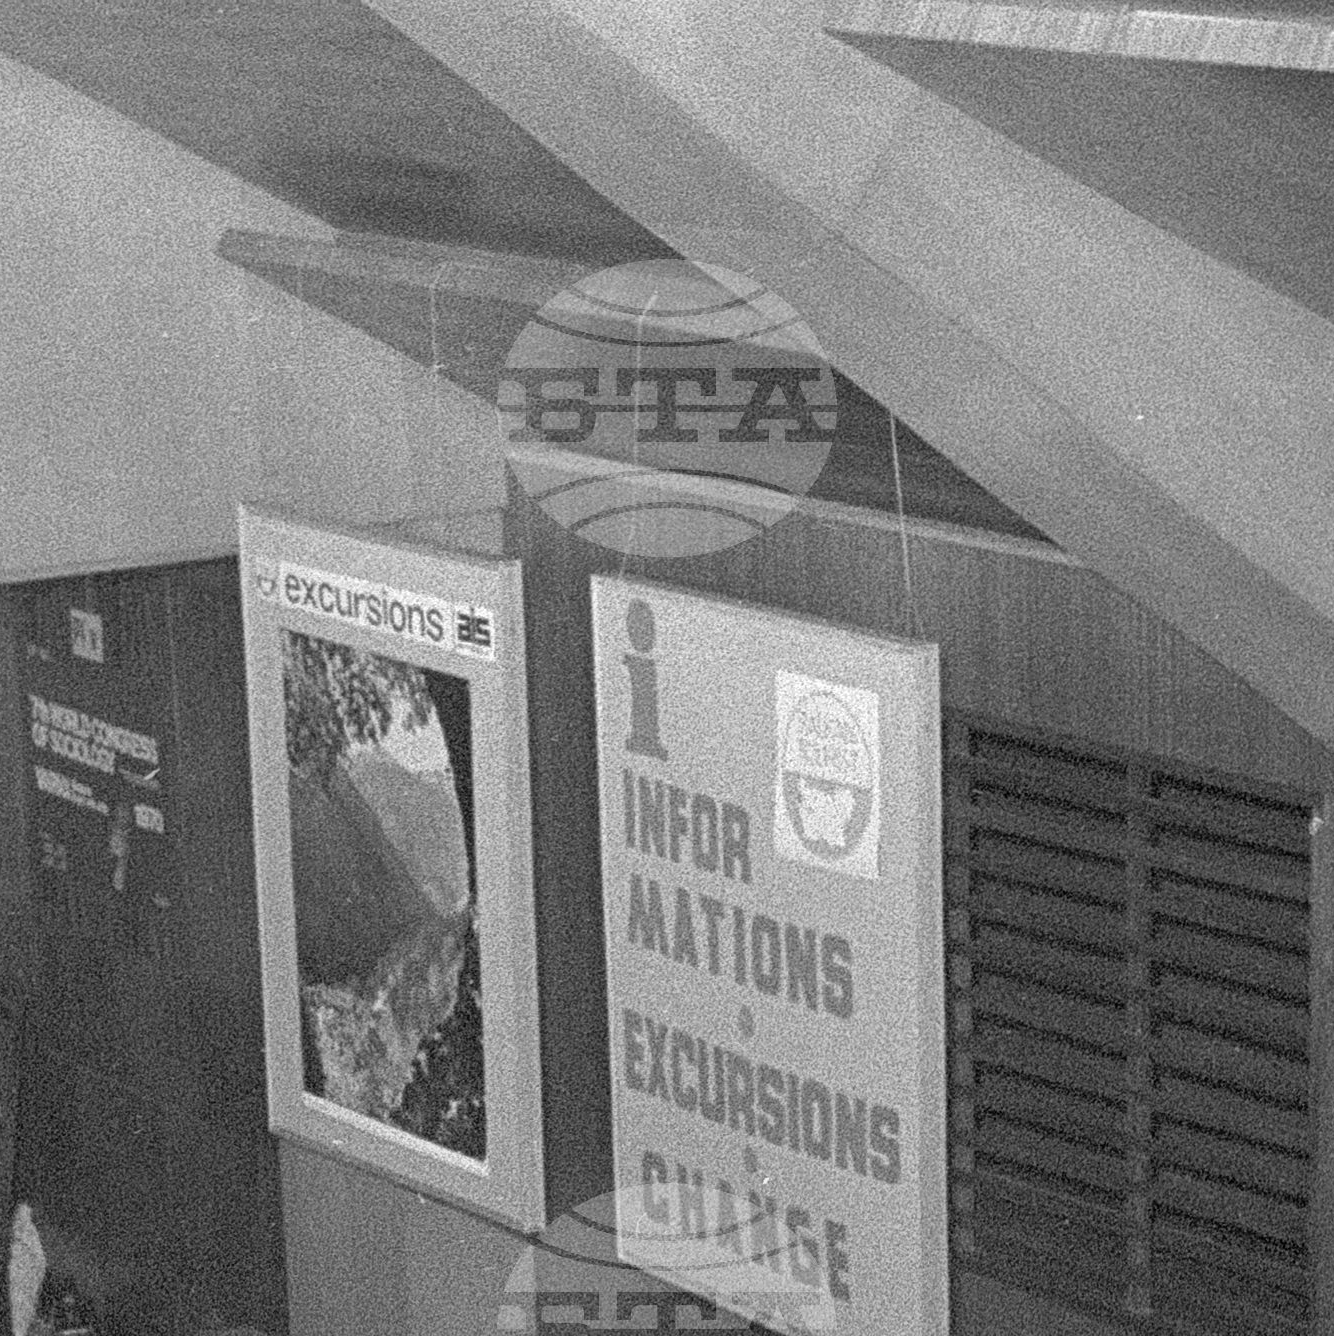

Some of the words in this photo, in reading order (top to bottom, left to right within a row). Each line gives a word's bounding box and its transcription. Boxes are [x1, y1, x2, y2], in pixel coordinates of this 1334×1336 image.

[284, 573, 445, 643] excursions
[623, 767, 754, 885] INFOR
[626, 872, 855, 1020] MATIONS
[622, 1006, 904, 1187] EXCURSIONS
[640, 1150, 853, 1304] CHANGE
